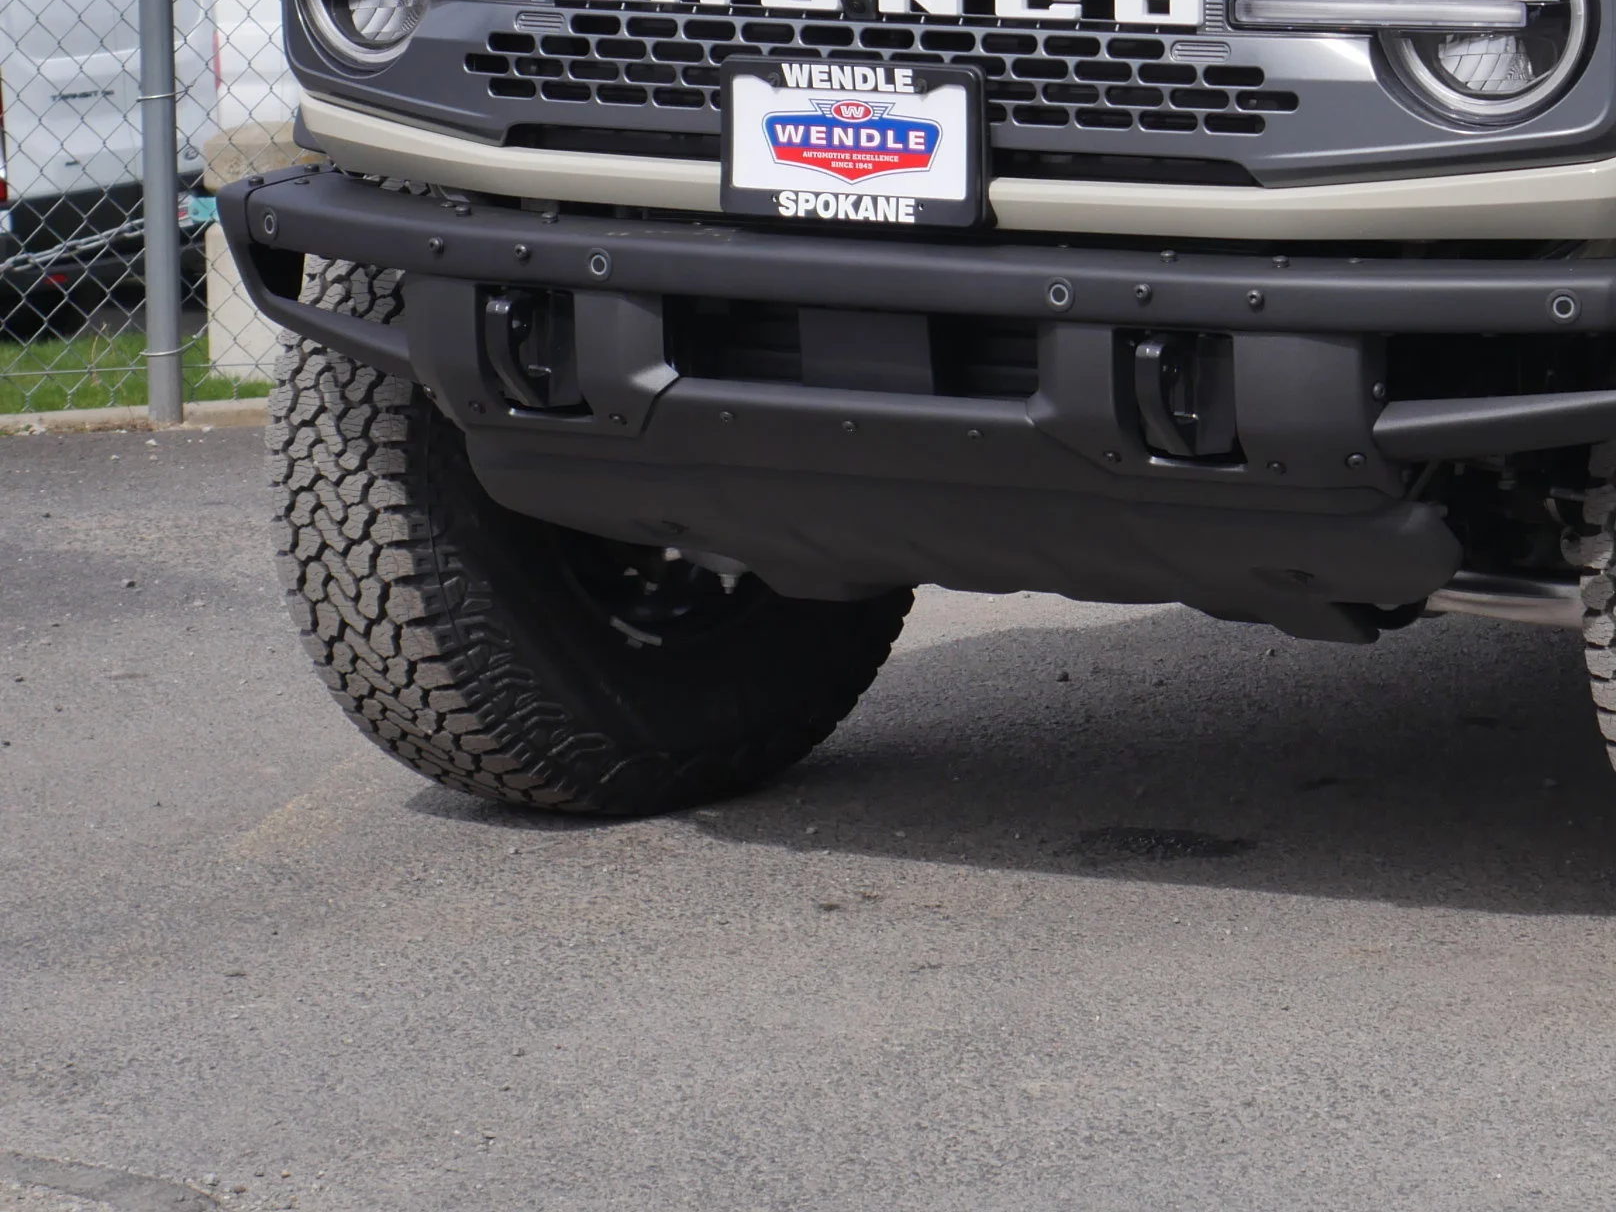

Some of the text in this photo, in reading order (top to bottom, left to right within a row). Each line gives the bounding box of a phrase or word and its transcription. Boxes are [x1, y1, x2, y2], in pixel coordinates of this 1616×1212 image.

[781, 63, 915, 93] WENDLE
[774, 124, 926, 150] WENDLE
[802, 151, 900, 162] AUTOMOTIVE EXCELLENCE
[778, 190, 916, 224] SPOKANE
